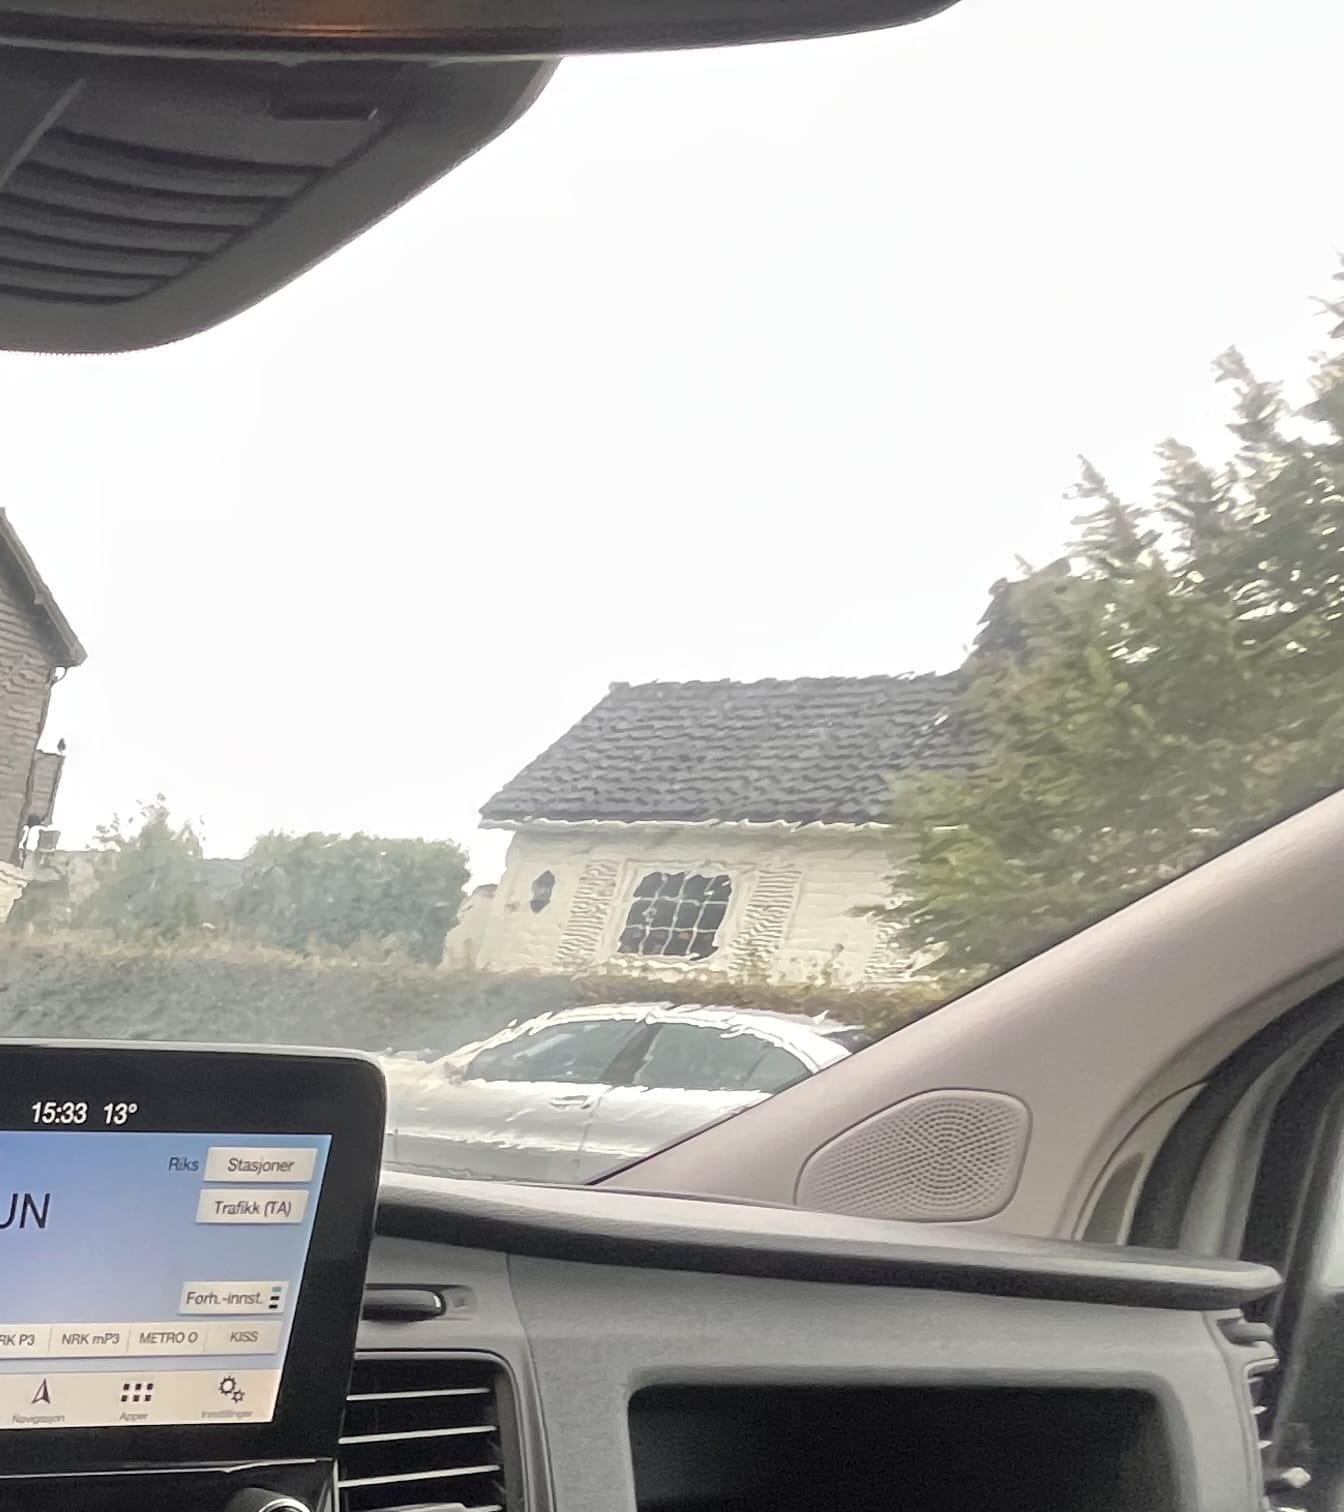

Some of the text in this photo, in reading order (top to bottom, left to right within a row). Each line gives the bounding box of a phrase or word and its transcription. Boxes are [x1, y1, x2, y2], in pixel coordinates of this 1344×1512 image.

[31, 1102, 138, 1125] 15:33 13°
[168, 1156, 295, 1175] Riks Stasjoner
[214, 1200, 292, 1218] Trafikk (TA)
[18, 1334, 36, 1346] P3
[61, 1332, 120, 1345] NRK mP3
[139, 1332, 185, 1344] METRO
[229, 1331, 259, 1342] KISS
